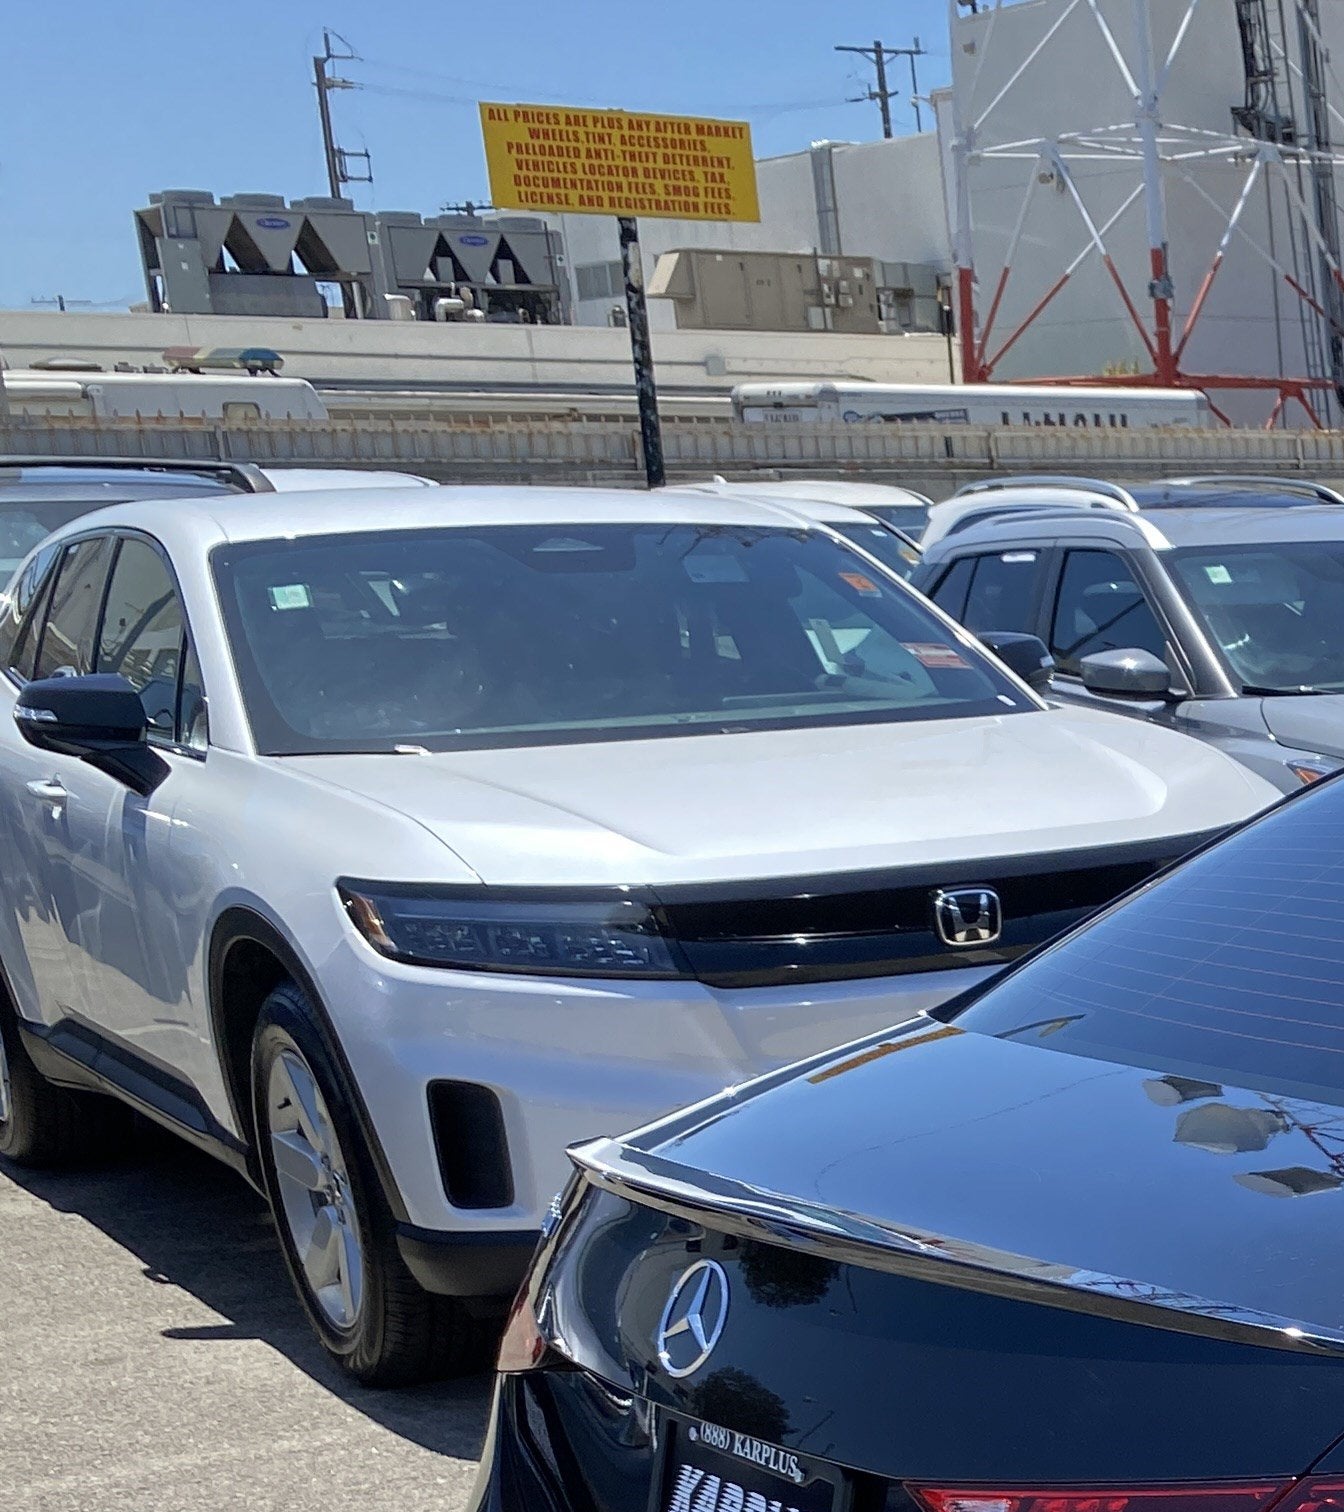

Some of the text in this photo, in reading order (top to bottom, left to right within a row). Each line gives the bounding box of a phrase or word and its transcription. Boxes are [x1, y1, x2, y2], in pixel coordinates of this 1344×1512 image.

[488, 107, 744, 140] ALL PRICES ARE PLUS ANY AFTER MARKET
[506, 141, 581, 159] PRELOADED
[585, 147, 657, 164] ANTI-THEFT
[515, 158, 578, 175] VEHICLES
[582, 162, 639, 179] LOCATOR
[513, 174, 624, 193] DOCUMENTATION
[664, 184, 700, 198] SMOG
[579, 194, 604, 208] AND
[609, 196, 700, 213] REGISTRATION
[700, 1422, 799, 1478] (888) KARPLUS
